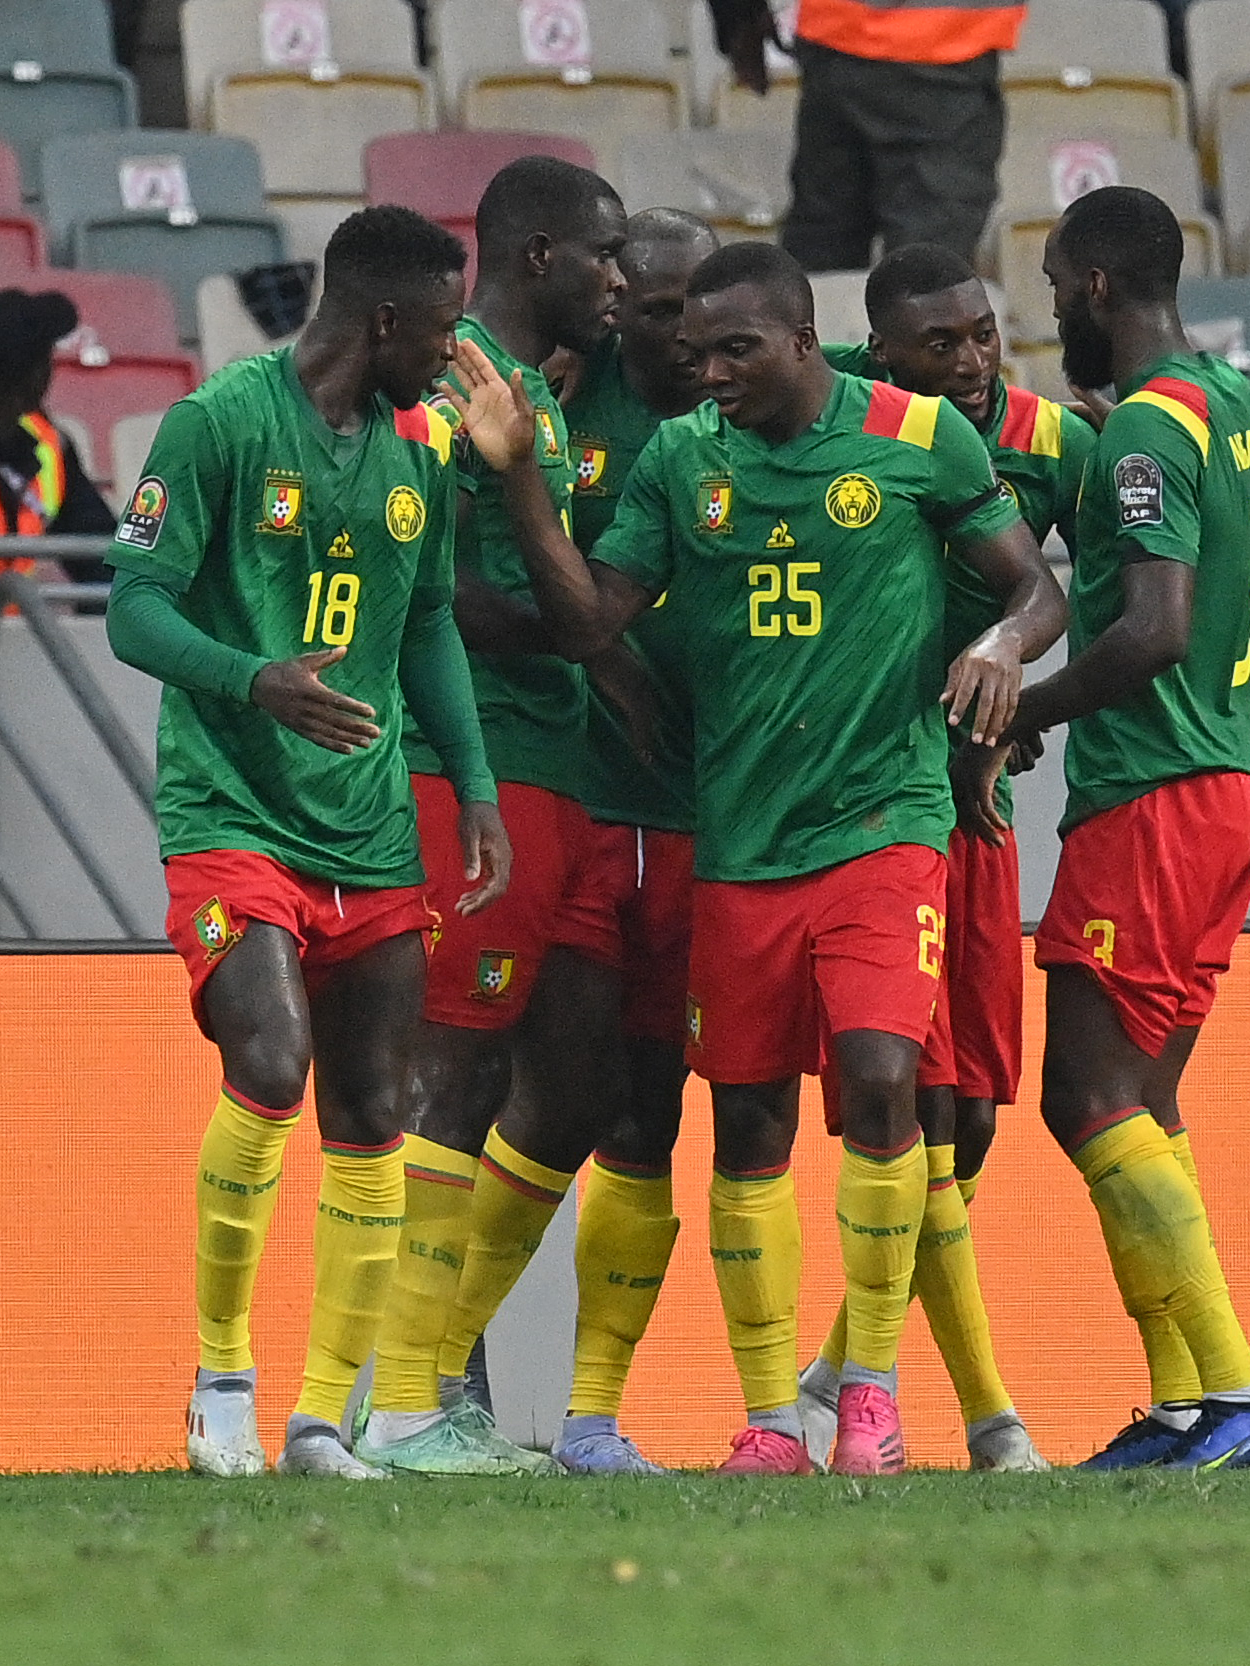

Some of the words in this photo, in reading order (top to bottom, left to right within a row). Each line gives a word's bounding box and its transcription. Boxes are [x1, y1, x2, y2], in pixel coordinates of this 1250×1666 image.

[1123, 509, 1150, 521] CAF
[302, 570, 361, 646] 18
[748, 562, 822, 637] 25
[1083, 919, 1115, 969] 3
